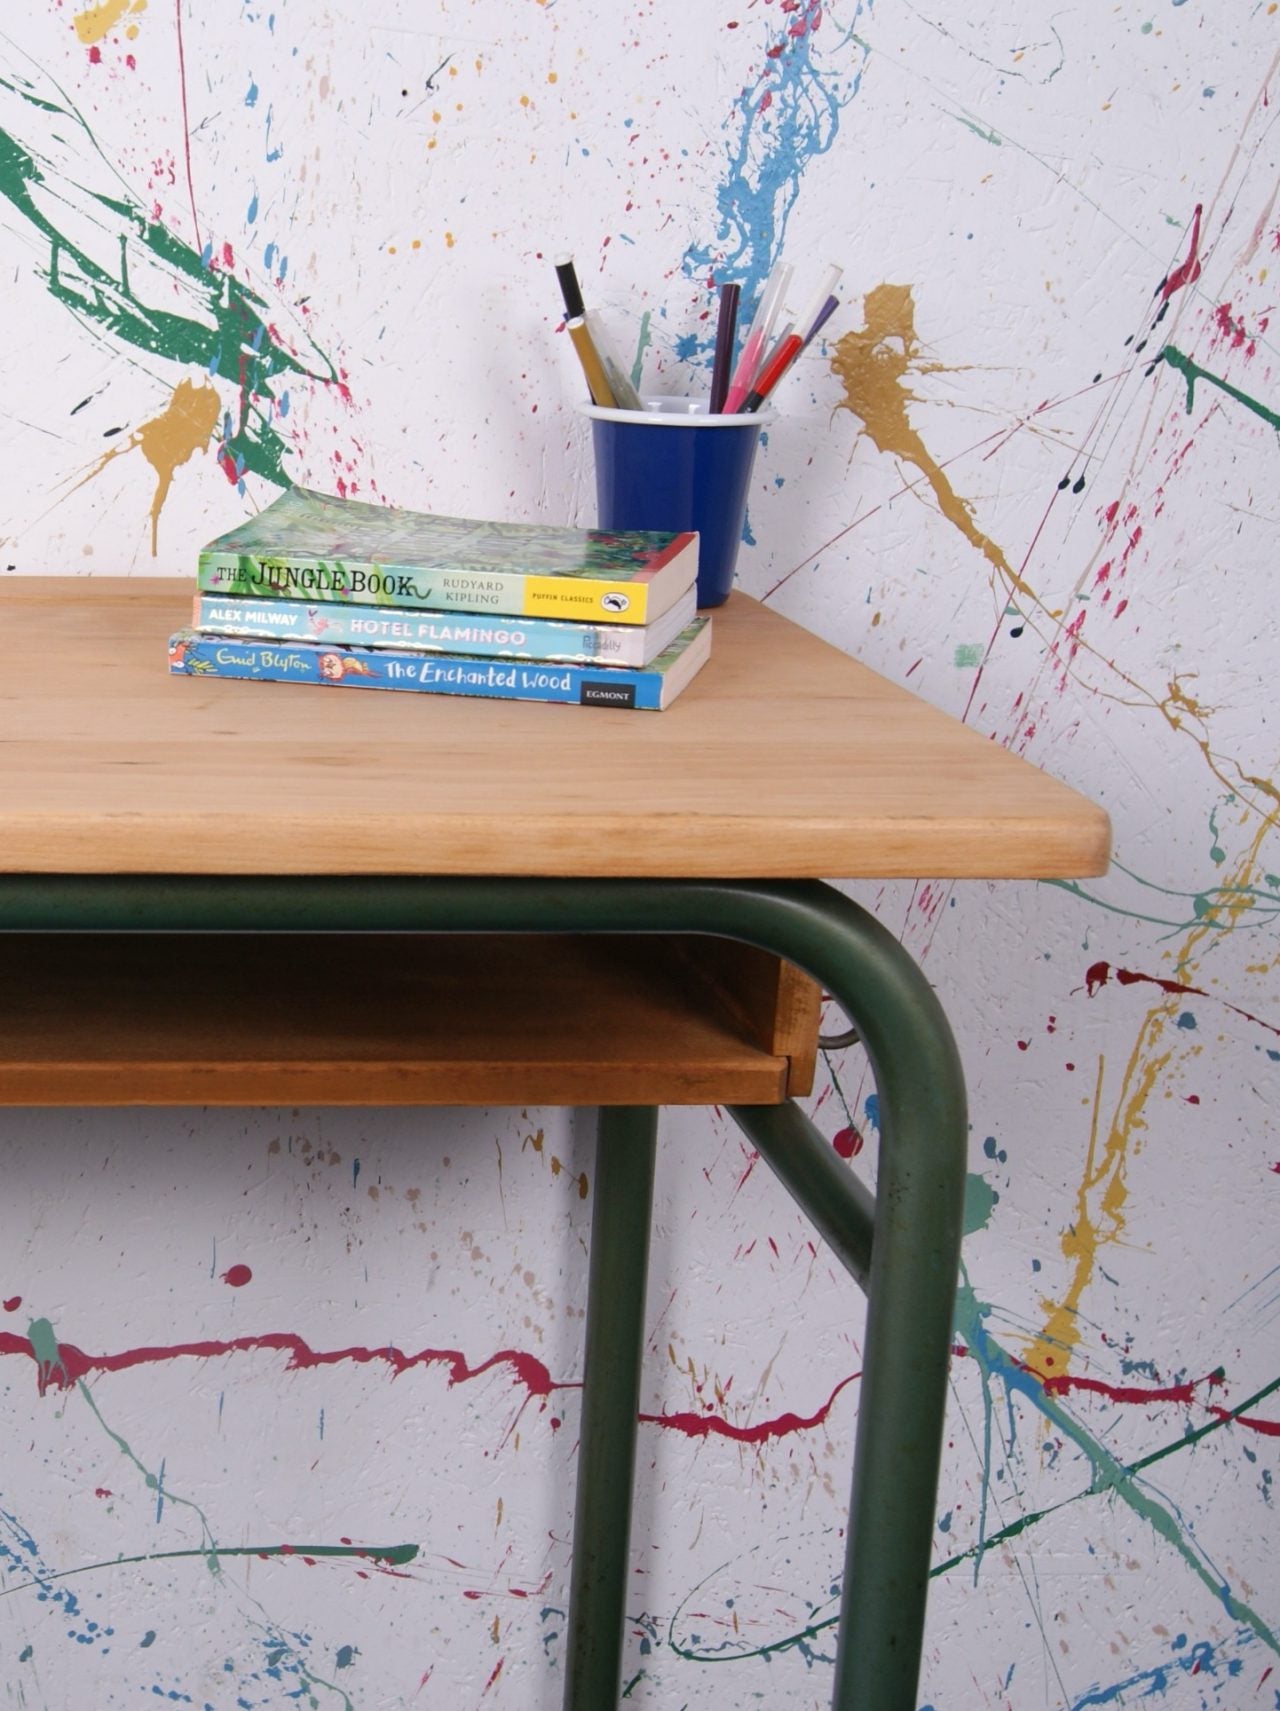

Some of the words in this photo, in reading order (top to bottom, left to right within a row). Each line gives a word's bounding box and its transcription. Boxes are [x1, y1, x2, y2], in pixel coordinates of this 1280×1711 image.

[217, 566, 247, 583] THE
[251, 562, 346, 591] JUNGLE
[350, 570, 424, 599] BOOK
[443, 578, 504, 592] RUDYARD
[445, 592, 500, 605] KIPLING
[532, 592, 558, 601] PUFFIN
[560, 595, 594, 604] CLASSICS
[209, 608, 241, 621] ALEX
[245, 611, 298, 626] MILWAY
[351, 619, 412, 637] HOTEL
[418, 624, 526, 646] FLAMINGO
[582, 634, 622, 652] Piccadilly
[216, 648, 255, 666] Enid
[260, 651, 312, 670] Blyton
[384, 660, 416, 679] The
[420, 663, 516, 688] Enchanted
[522, 672, 572, 691] Wood
[586, 690, 630, 701] EGMONT
